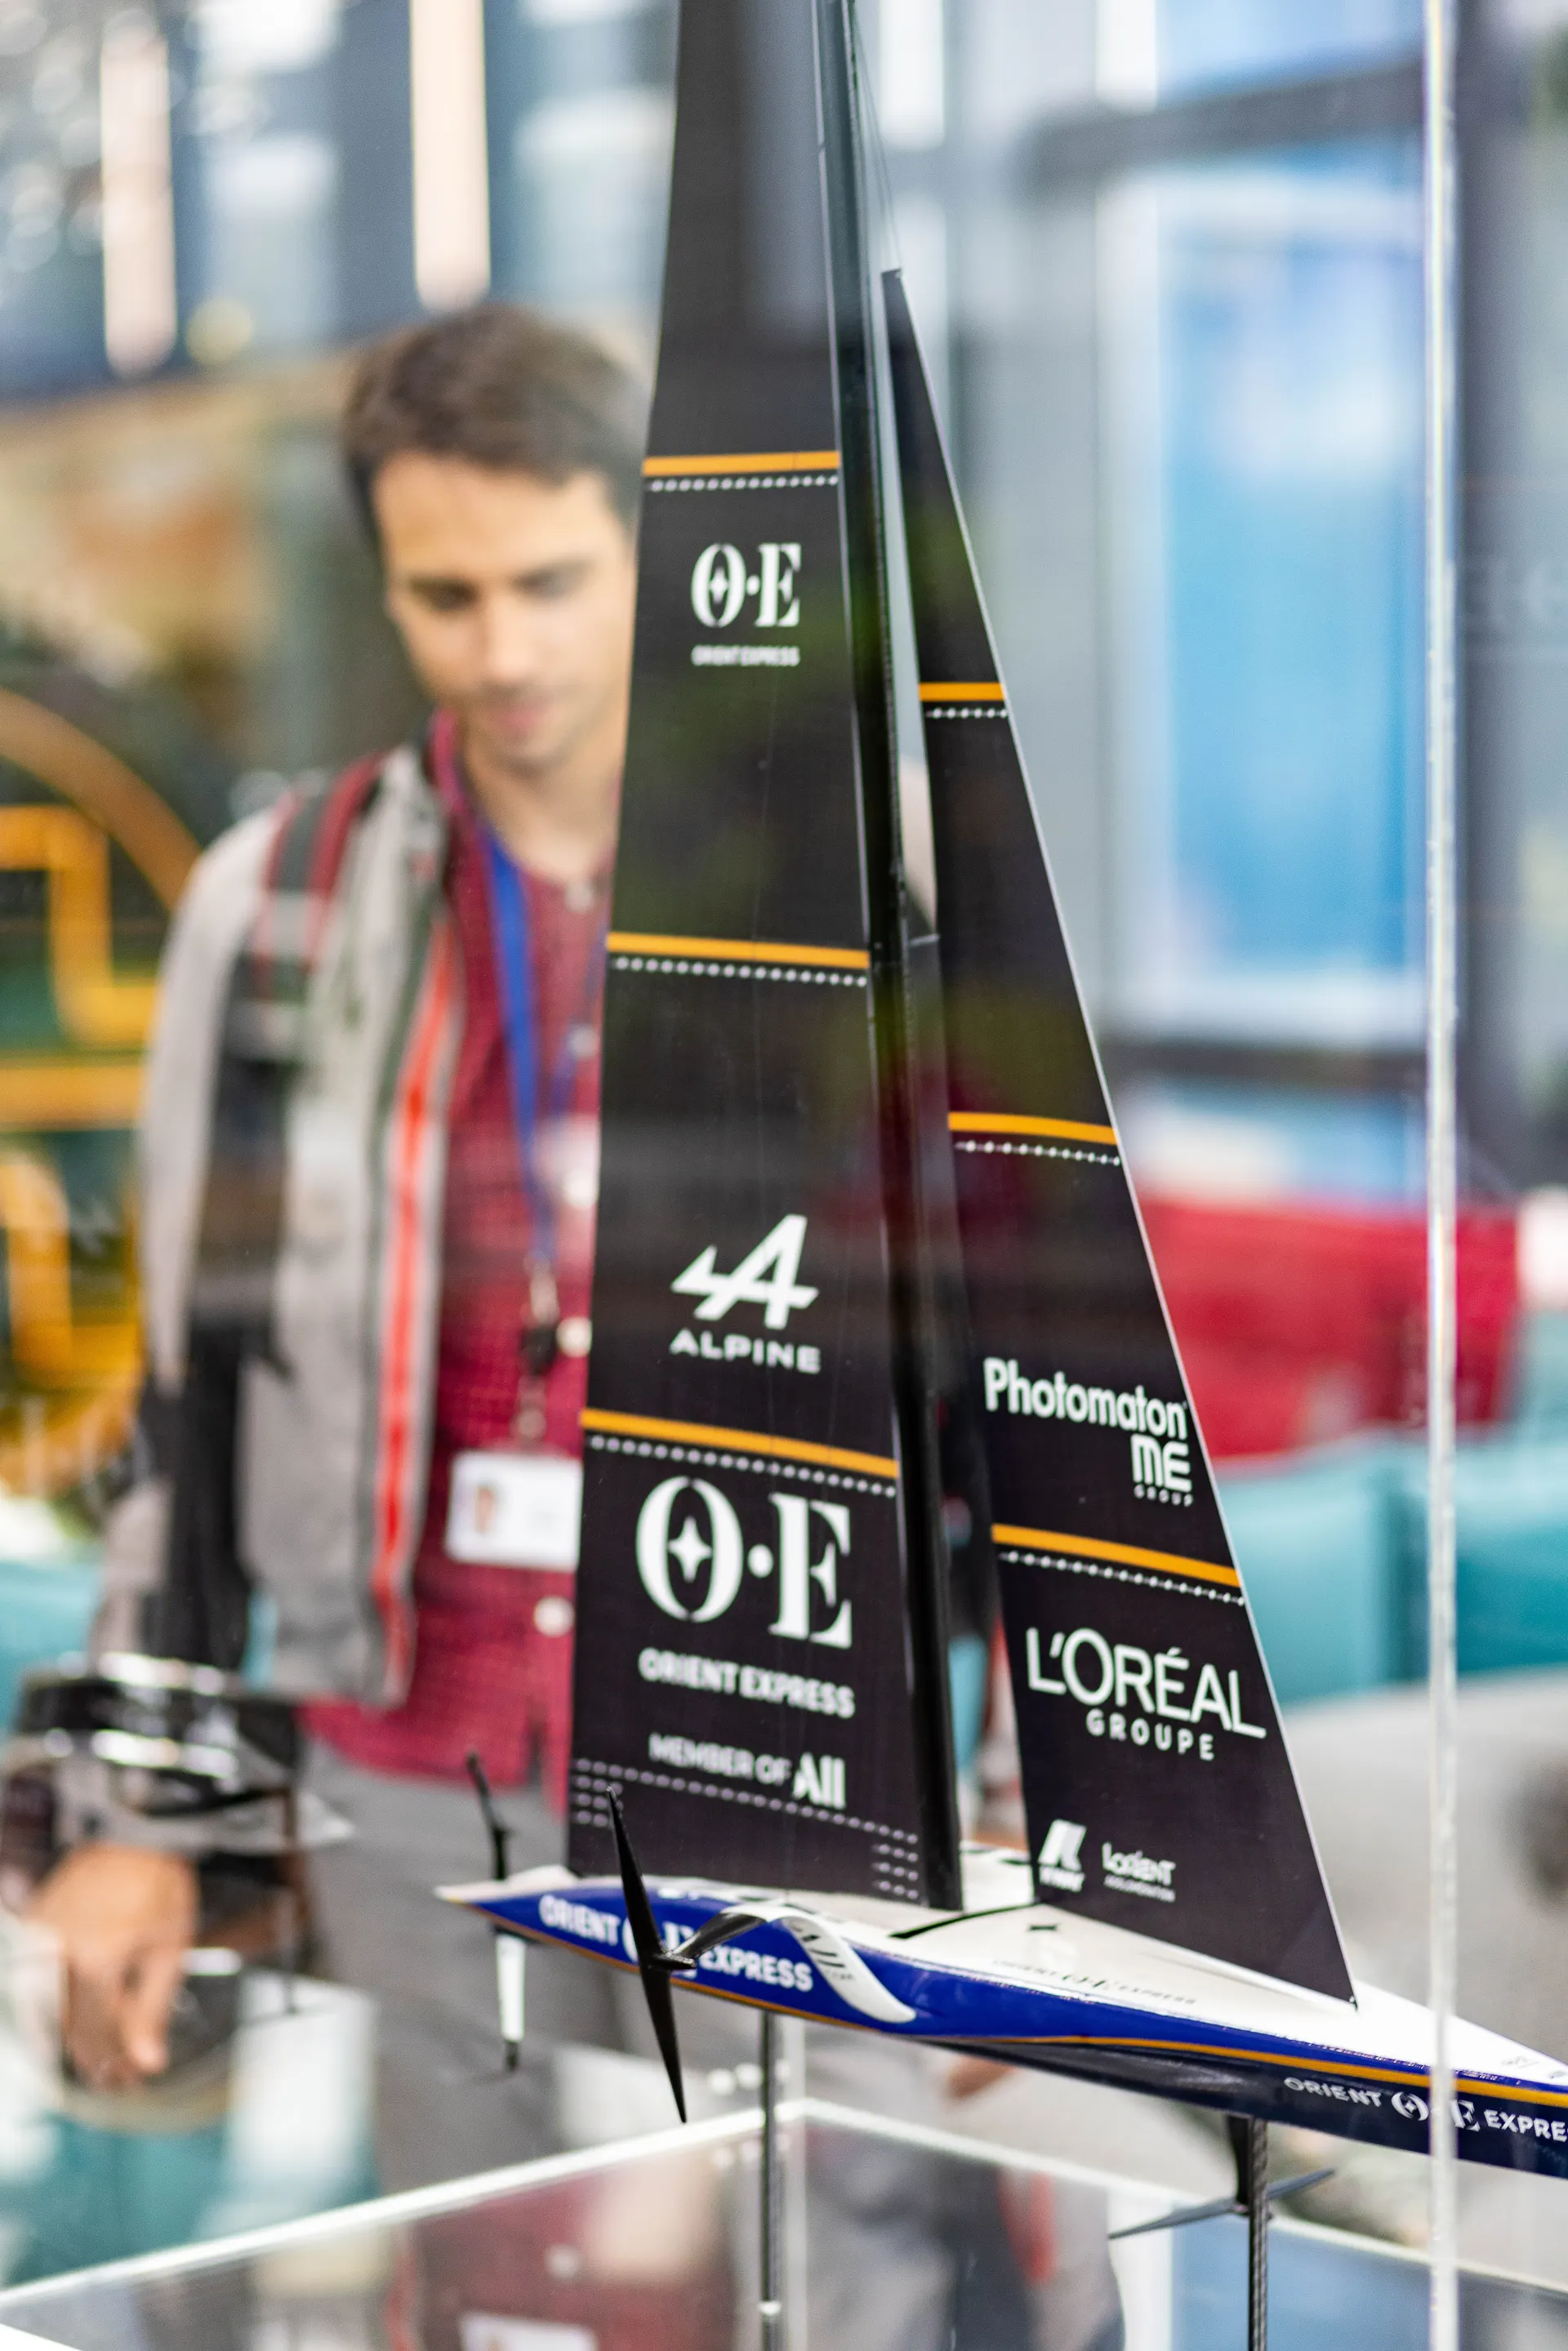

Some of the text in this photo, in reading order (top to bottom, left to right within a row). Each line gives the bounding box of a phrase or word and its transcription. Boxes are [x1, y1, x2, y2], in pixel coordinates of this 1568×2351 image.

[668, 1326, 822, 1374] ALPINE
[983, 1356, 1188, 1440] Photomaton
[1130, 1433, 1192, 1493] ME
[1134, 1484, 1193, 1507] GROUP
[638, 1647, 855, 1719] ORIENT EXPRESS
[1027, 1627, 1267, 1739] L'ORÉAL
[649, 1733, 755, 1779] MEMBER
[755, 1753, 792, 1785] OF
[1086, 1708, 1214, 1761] GROUPE
[538, 1894, 621, 1946] ORIENT
[698, 1944, 813, 1993] EXPRESS
[1283, 2077, 1383, 2108] ORIENT
[1483, 2108, 1568, 2143] EXPRE
